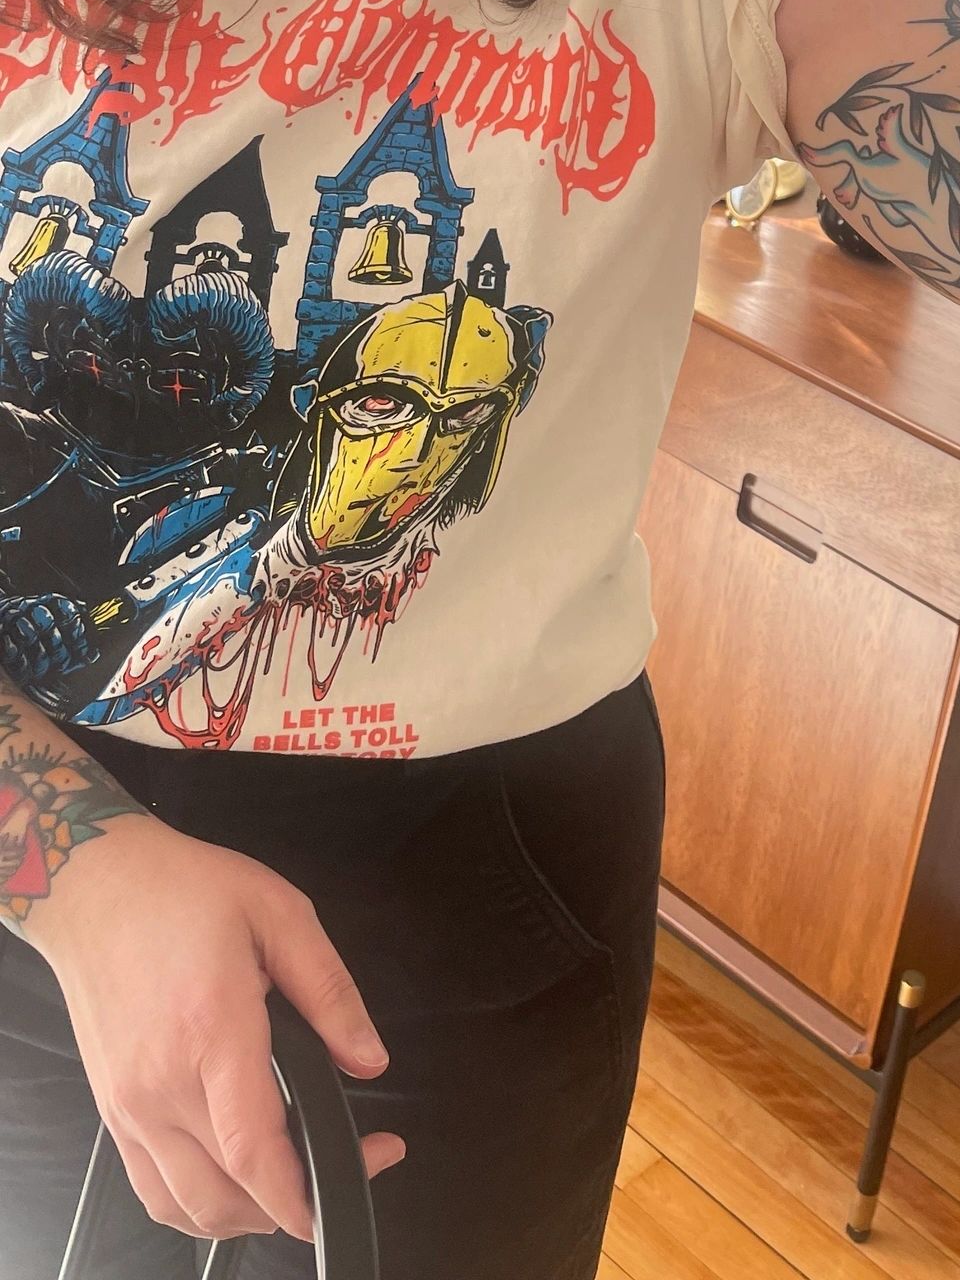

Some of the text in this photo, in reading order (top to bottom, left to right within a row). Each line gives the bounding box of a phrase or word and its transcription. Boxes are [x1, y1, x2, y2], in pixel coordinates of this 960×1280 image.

[282, 702, 396, 730] LET THE
[253, 723, 420, 752] BELLS TOLL
